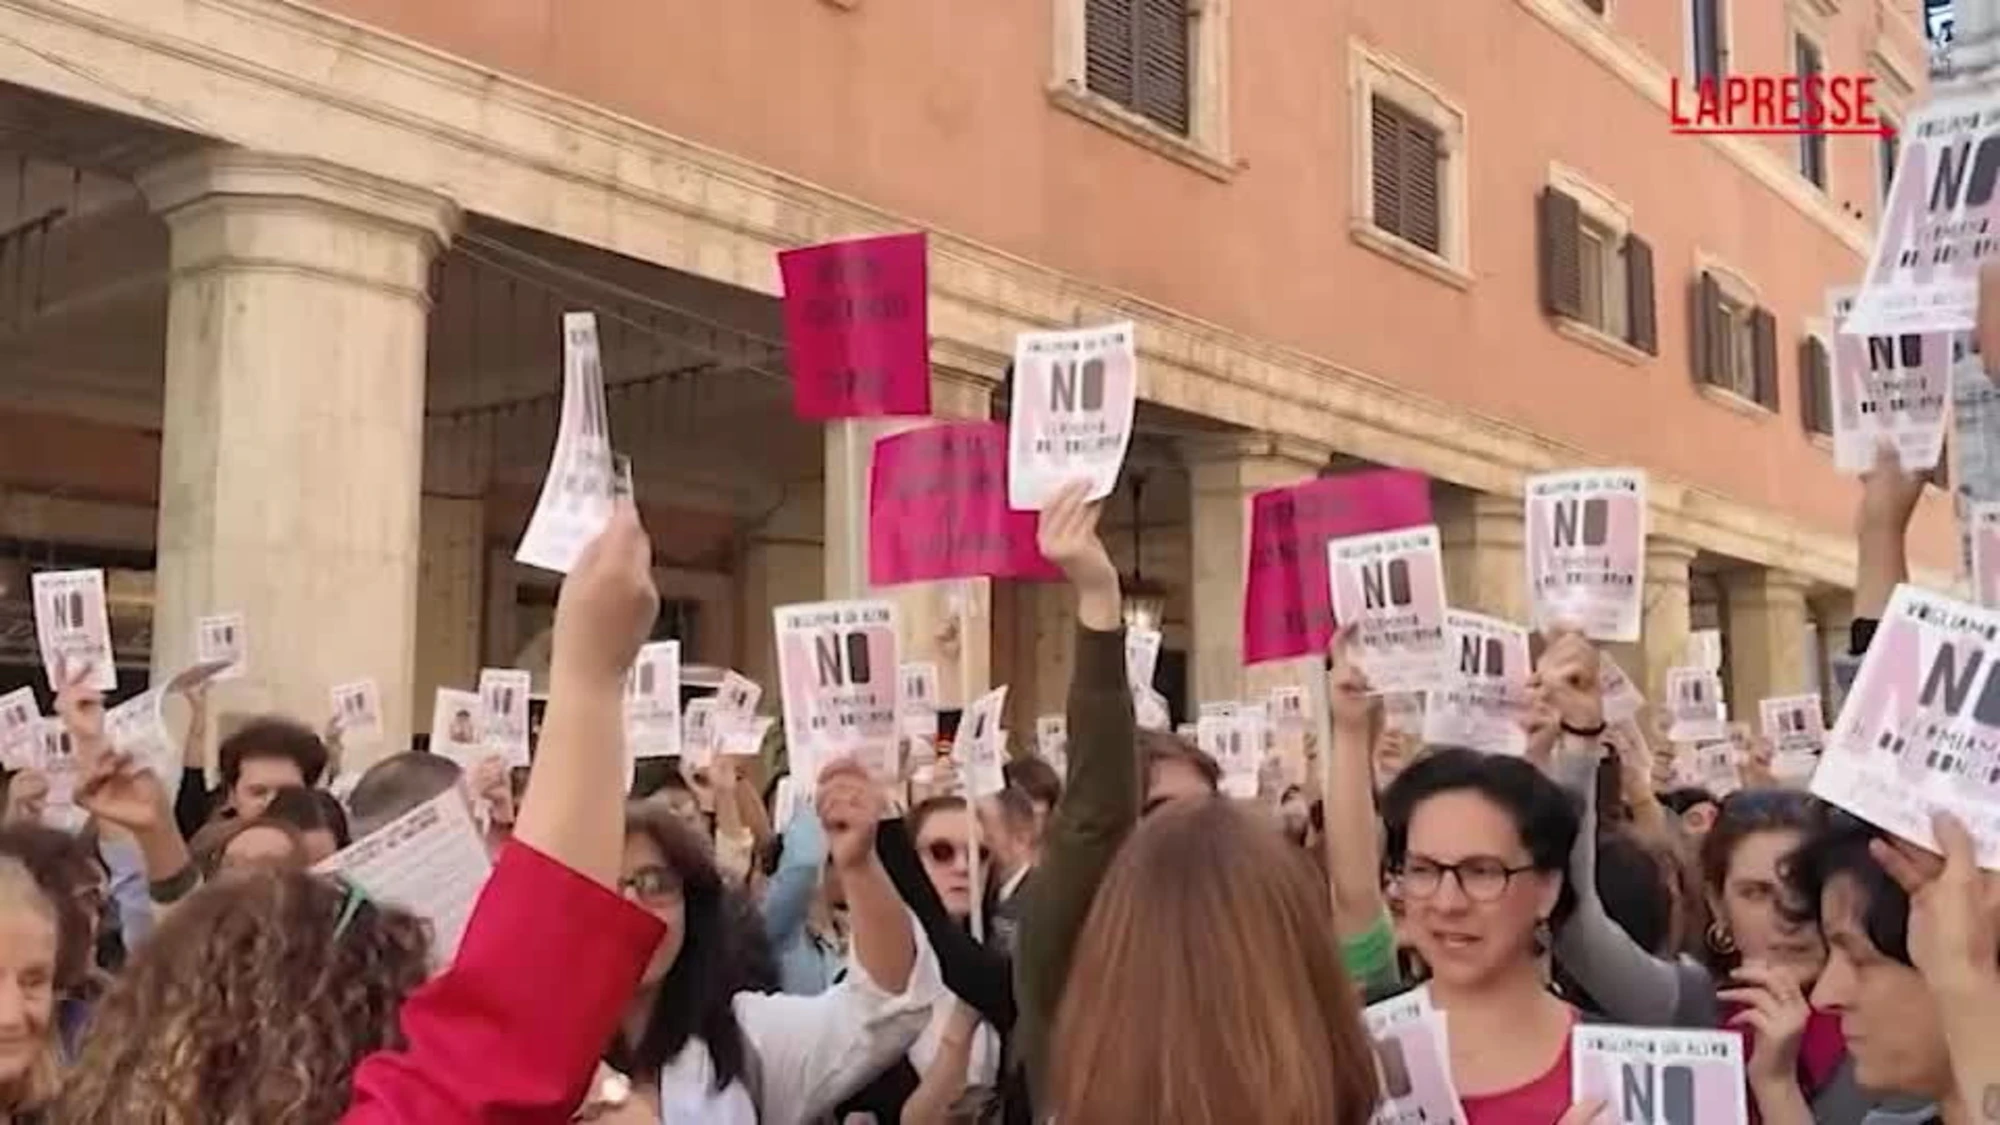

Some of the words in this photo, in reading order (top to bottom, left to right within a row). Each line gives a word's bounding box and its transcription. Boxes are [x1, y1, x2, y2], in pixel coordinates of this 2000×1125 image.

[1051, 358, 1104, 413] NO
[1554, 499, 1609, 547] NO
[1361, 558, 1412, 609] NO
[815, 631, 870, 687] NO
[1460, 634, 1504, 677] NO
[1621, 1062, 1695, 1125] NO
